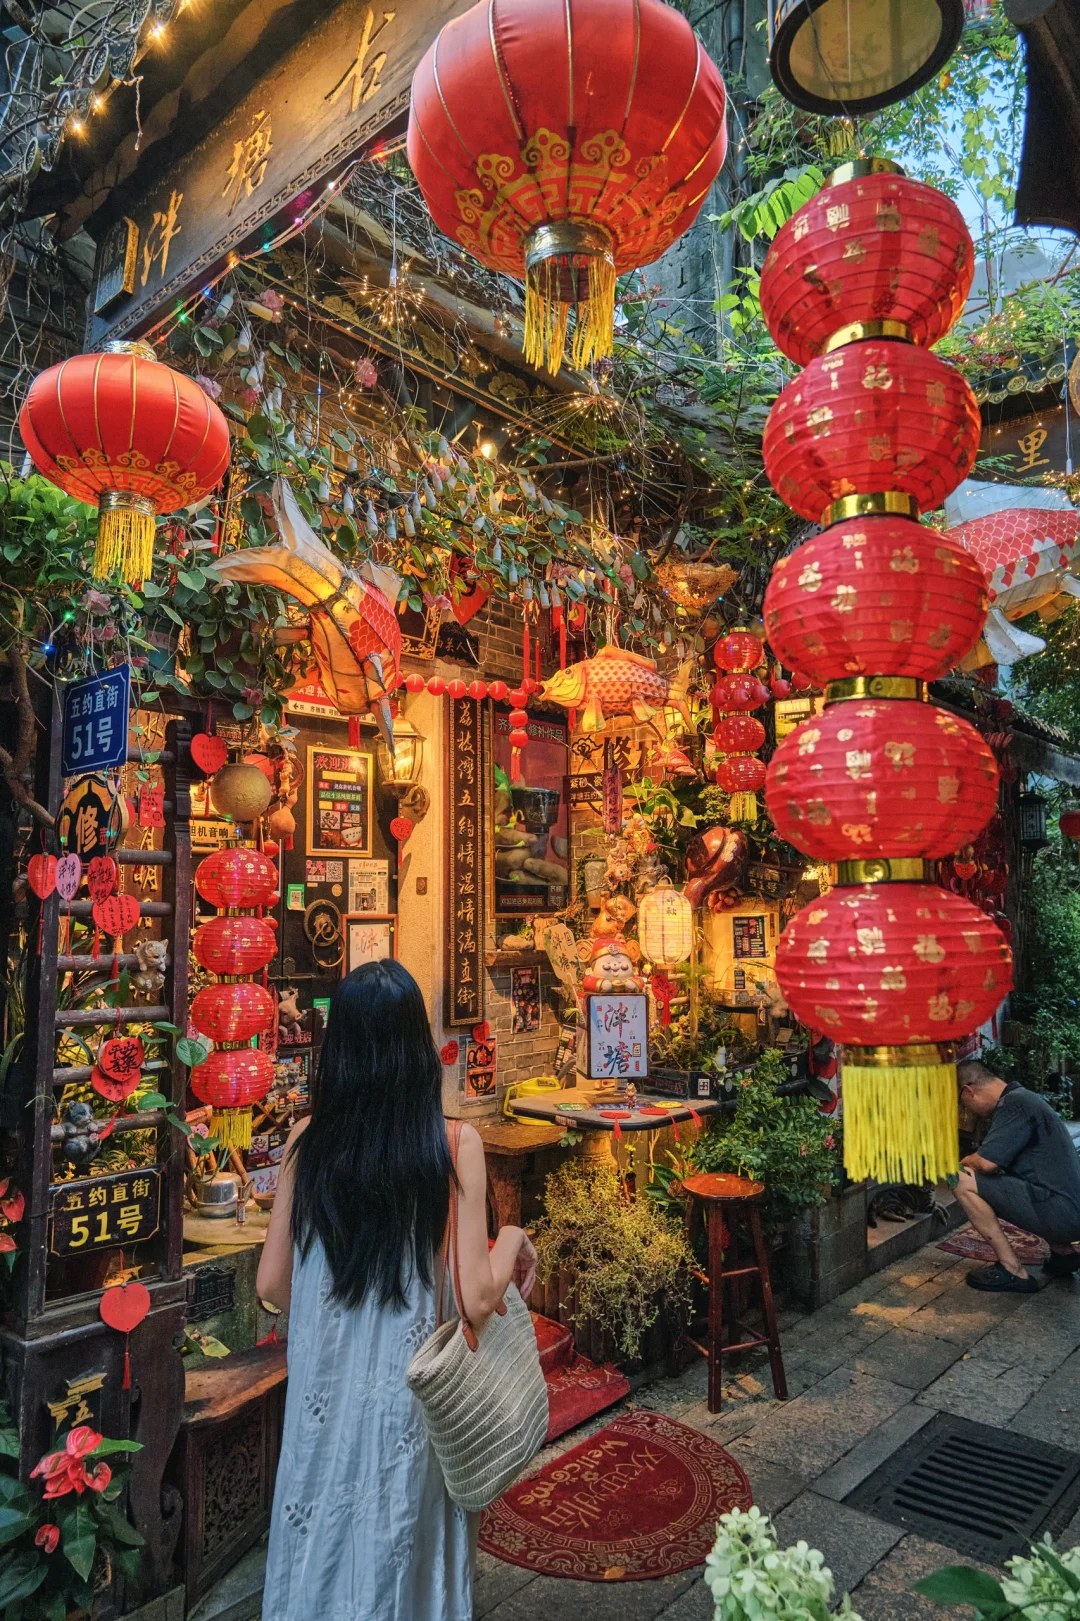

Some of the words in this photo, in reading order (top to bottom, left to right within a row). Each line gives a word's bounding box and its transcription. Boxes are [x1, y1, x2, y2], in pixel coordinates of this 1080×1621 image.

[70, 685, 119, 719] 五约直街
[71, 716, 114, 760] 51号
[76, 805, 99, 854] 修
[603, 1001, 632, 1076] 泮塘
[65, 1178, 150, 1211] 五约直街
[69, 1203, 143, 1248] 51号
